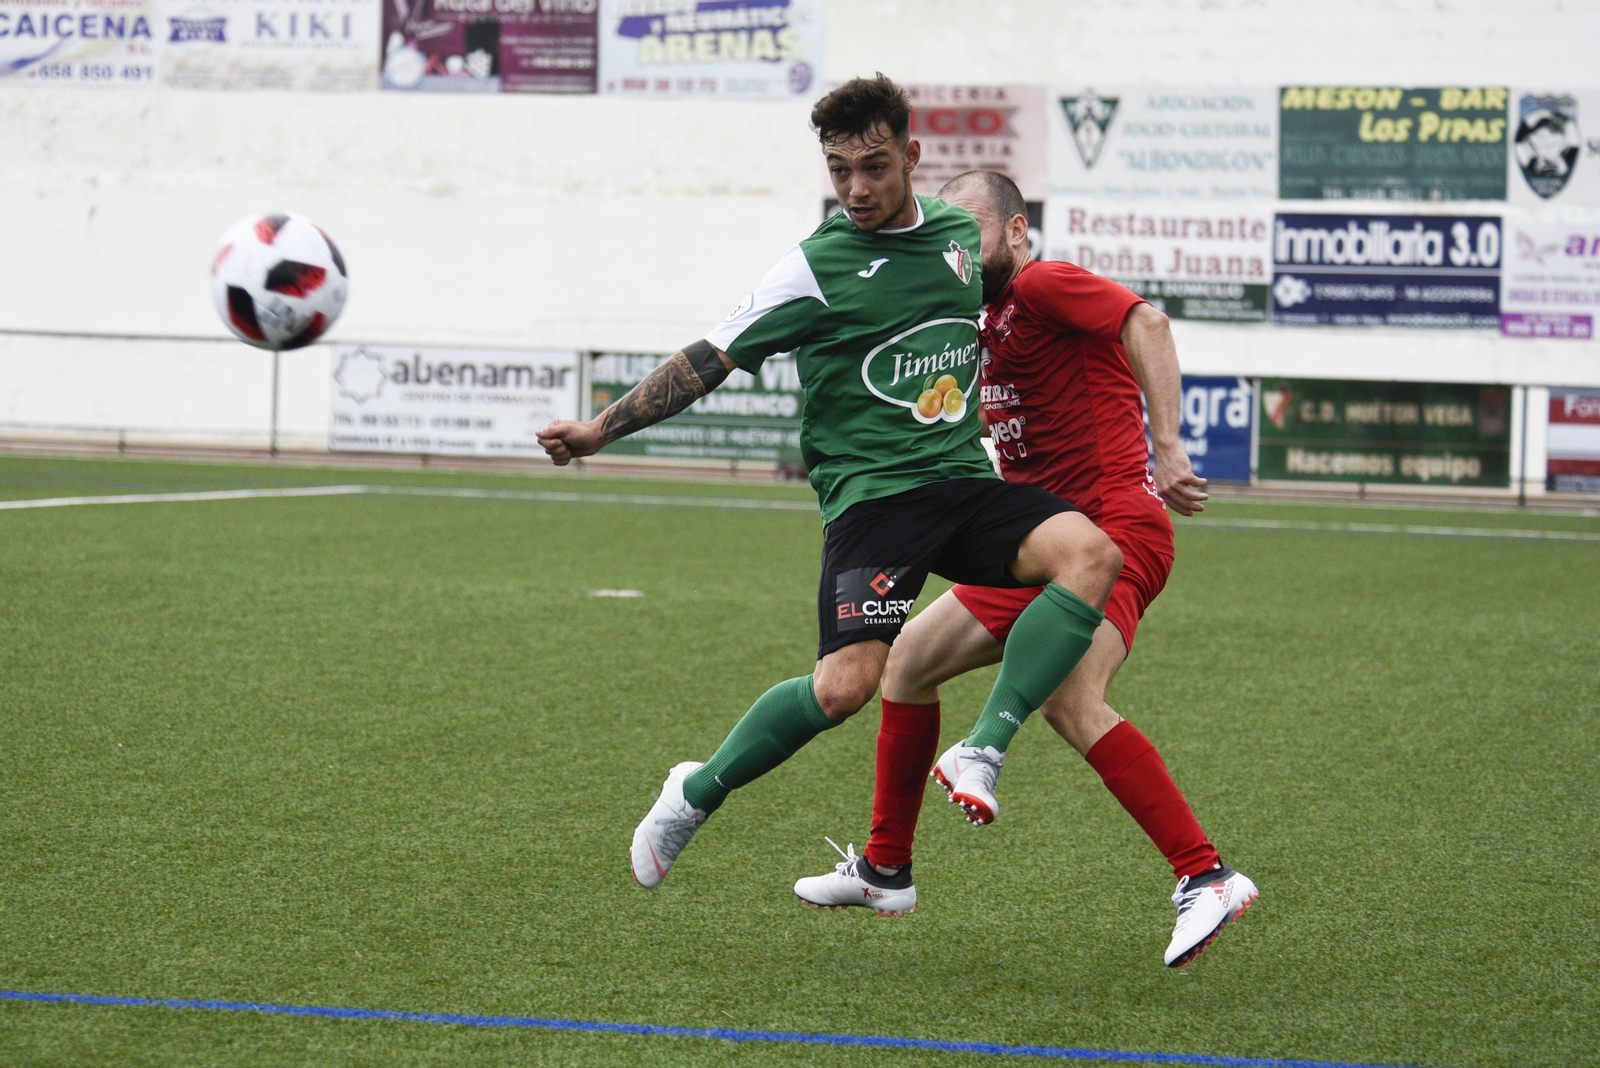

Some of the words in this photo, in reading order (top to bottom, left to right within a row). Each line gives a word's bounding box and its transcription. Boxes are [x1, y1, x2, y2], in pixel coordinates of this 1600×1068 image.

[255, 12, 351, 38] KIKI
[638, 29, 802, 64] ARENAS
[907, 86, 1006, 101] NICERIA
[1283, 88, 1402, 110] MESON
[1439, 88, 1507, 110] BAR
[909, 107, 1003, 136] ICO
[1068, 208, 1267, 241] Restaurante
[1449, 221, 1501, 267] 3.0
[1077, 245, 1154, 274] Doña
[1166, 248, 1265, 278] Juana
[391, 354, 577, 390] abenamar
[890, 342, 977, 386] Jiménez
[692, 393, 798, 418] LAMENCO
[1181, 386, 1250, 439] gra
[1399, 452, 1482, 484] equipo
[864, 617, 901, 625] CERAMICAS
